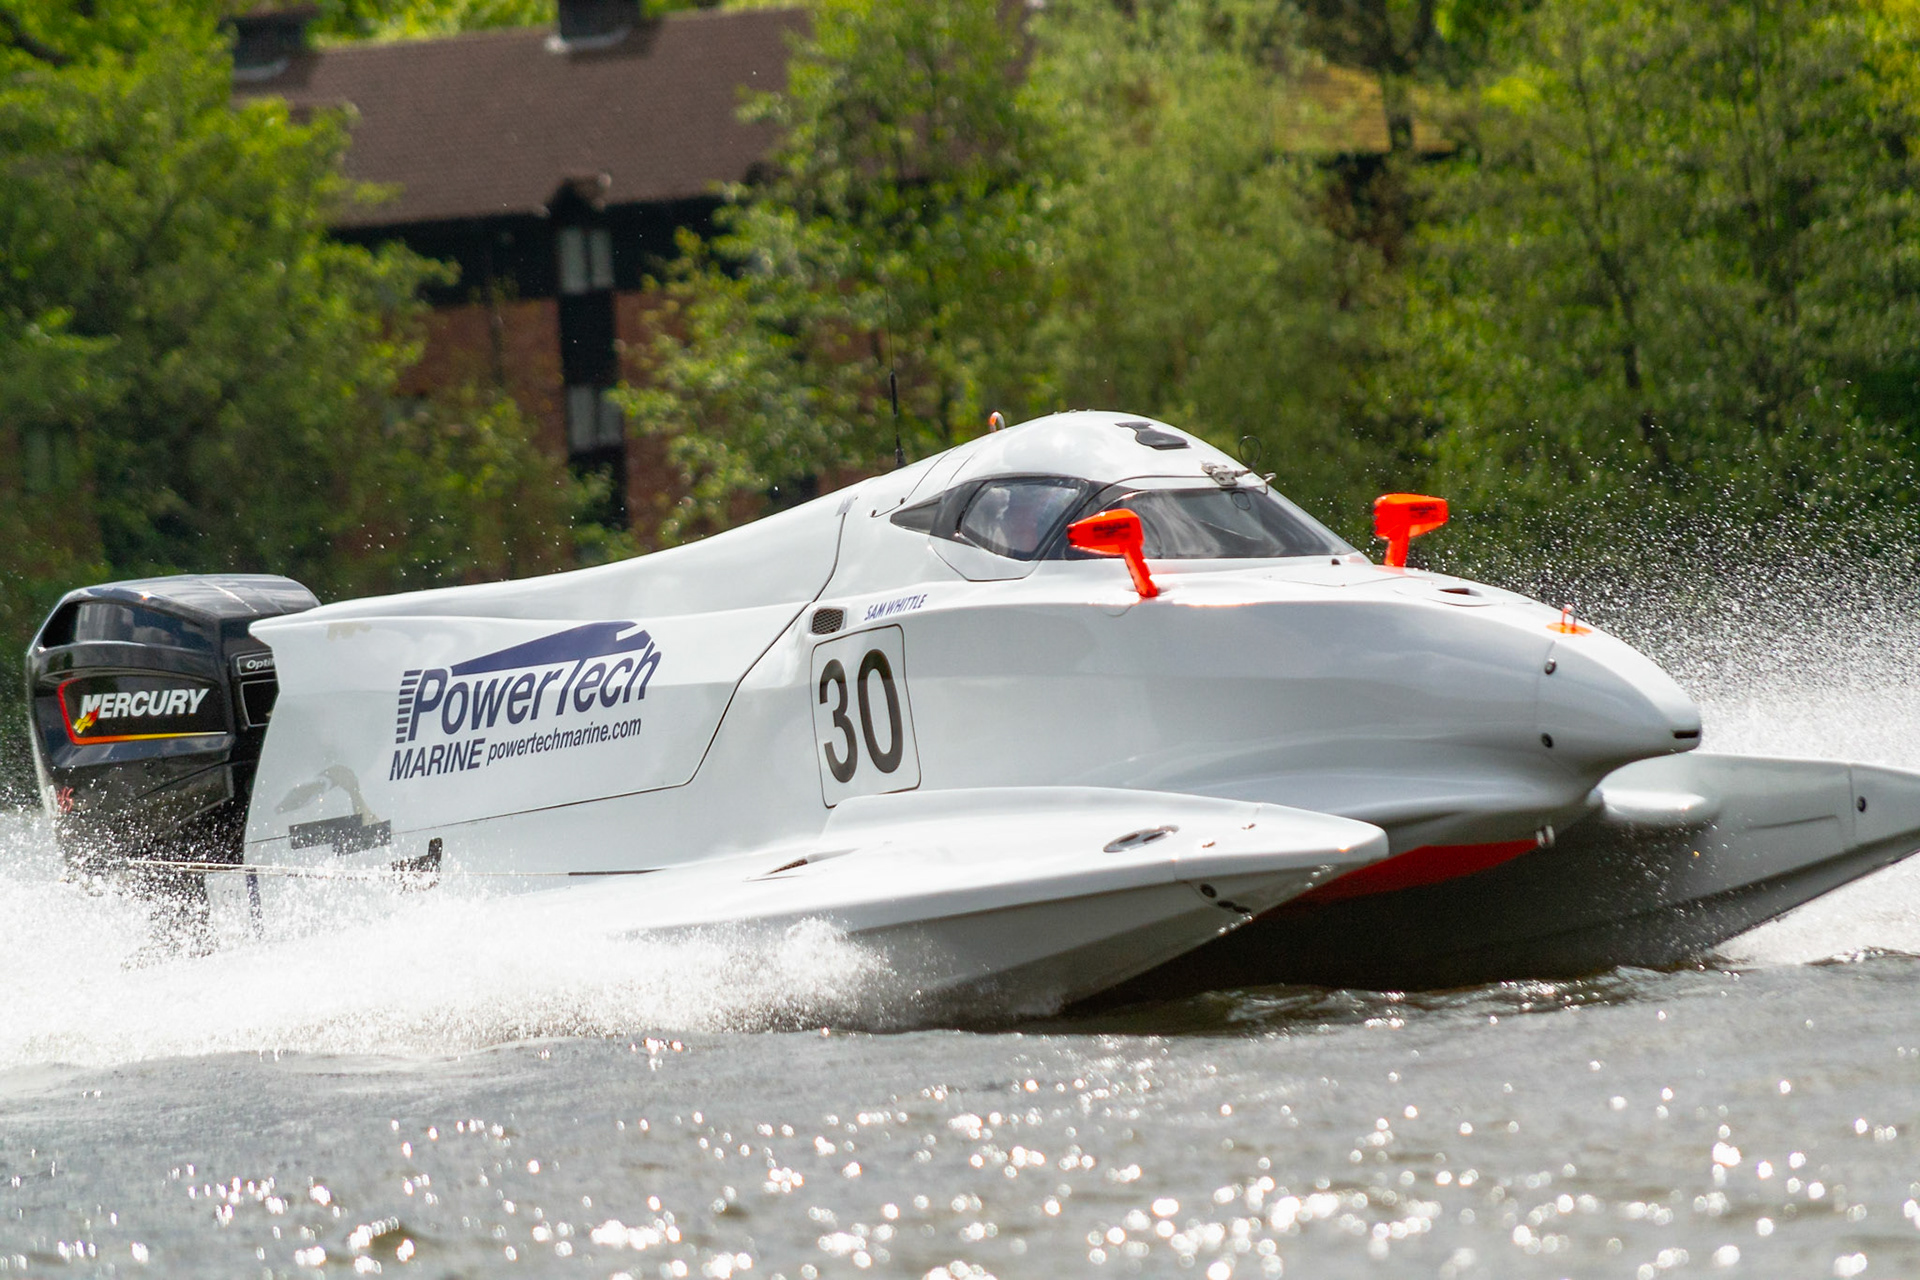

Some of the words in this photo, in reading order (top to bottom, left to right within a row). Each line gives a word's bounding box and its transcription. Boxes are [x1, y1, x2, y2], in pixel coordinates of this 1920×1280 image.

[864, 602, 887, 621] SAM
[886, 593, 928, 616] WHITTLE
[80, 688, 209, 719] MERCURY
[407, 641, 662, 741] PowerTech
[819, 648, 904, 783] 30
[389, 738, 486, 781] MARINE
[487, 718, 642, 766] powertechmarine.com
